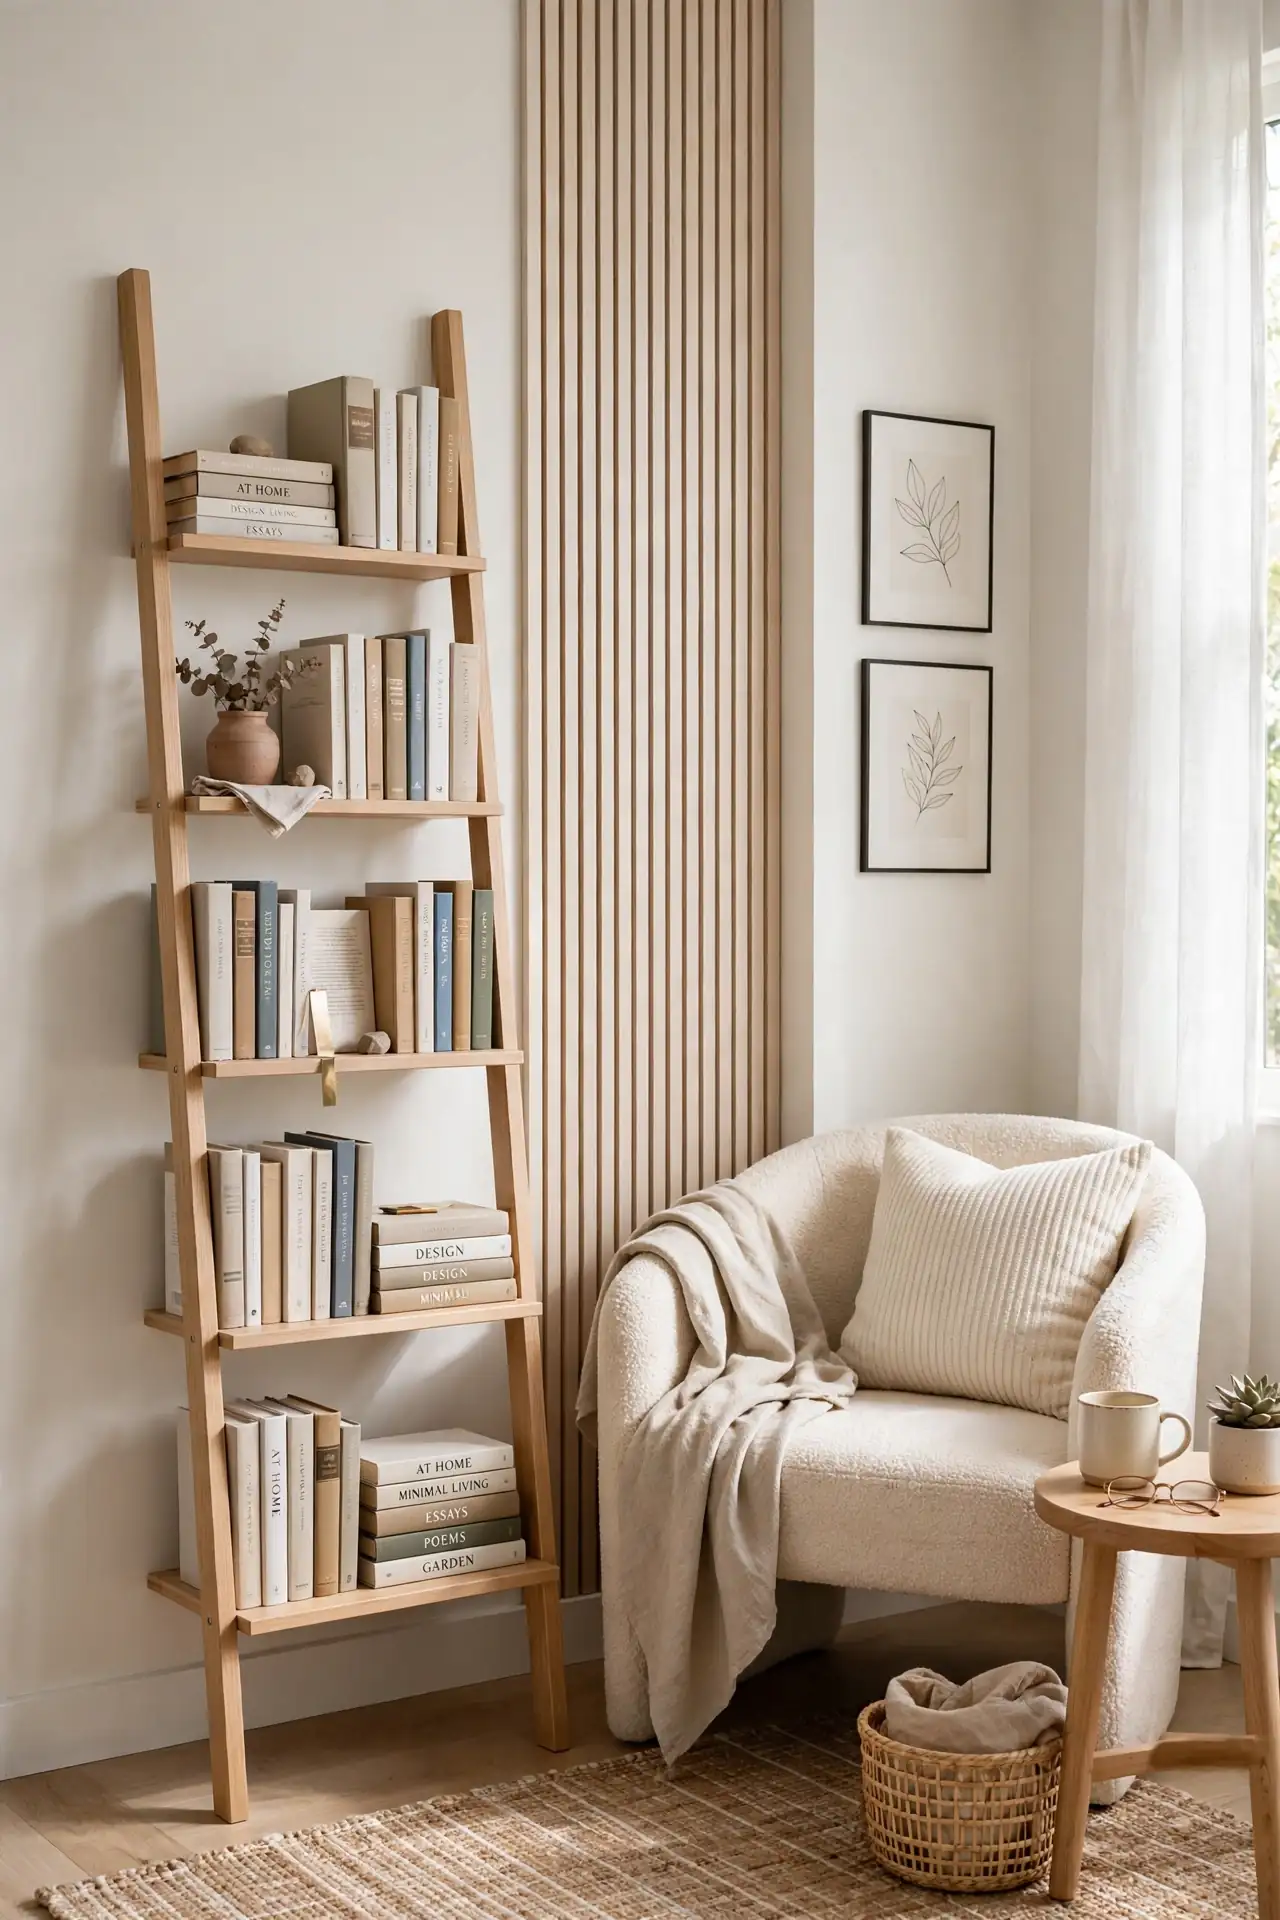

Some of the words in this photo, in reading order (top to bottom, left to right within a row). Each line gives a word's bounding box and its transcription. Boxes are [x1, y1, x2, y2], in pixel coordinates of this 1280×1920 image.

[237, 483, 252, 494] AT
[255, 484, 291, 498] HOME
[245, 525, 283, 537] ESSAYS
[416, 1244, 464, 1260] DESIGN
[423, 1267, 468, 1282] DESIGN
[272, 1448, 281, 1466] AT
[416, 1462, 432, 1475] AT
[435, 1457, 472, 1472] HOME
[272, 1473, 281, 1518] HOME
[398, 1483, 448, 1501] MINIMAL
[452, 1478, 489, 1493] LIVING
[425, 1506, 468, 1524] ESSAYS
[424, 1531, 466, 1549] POEMS
[422, 1554, 475, 1573] GARDEN
